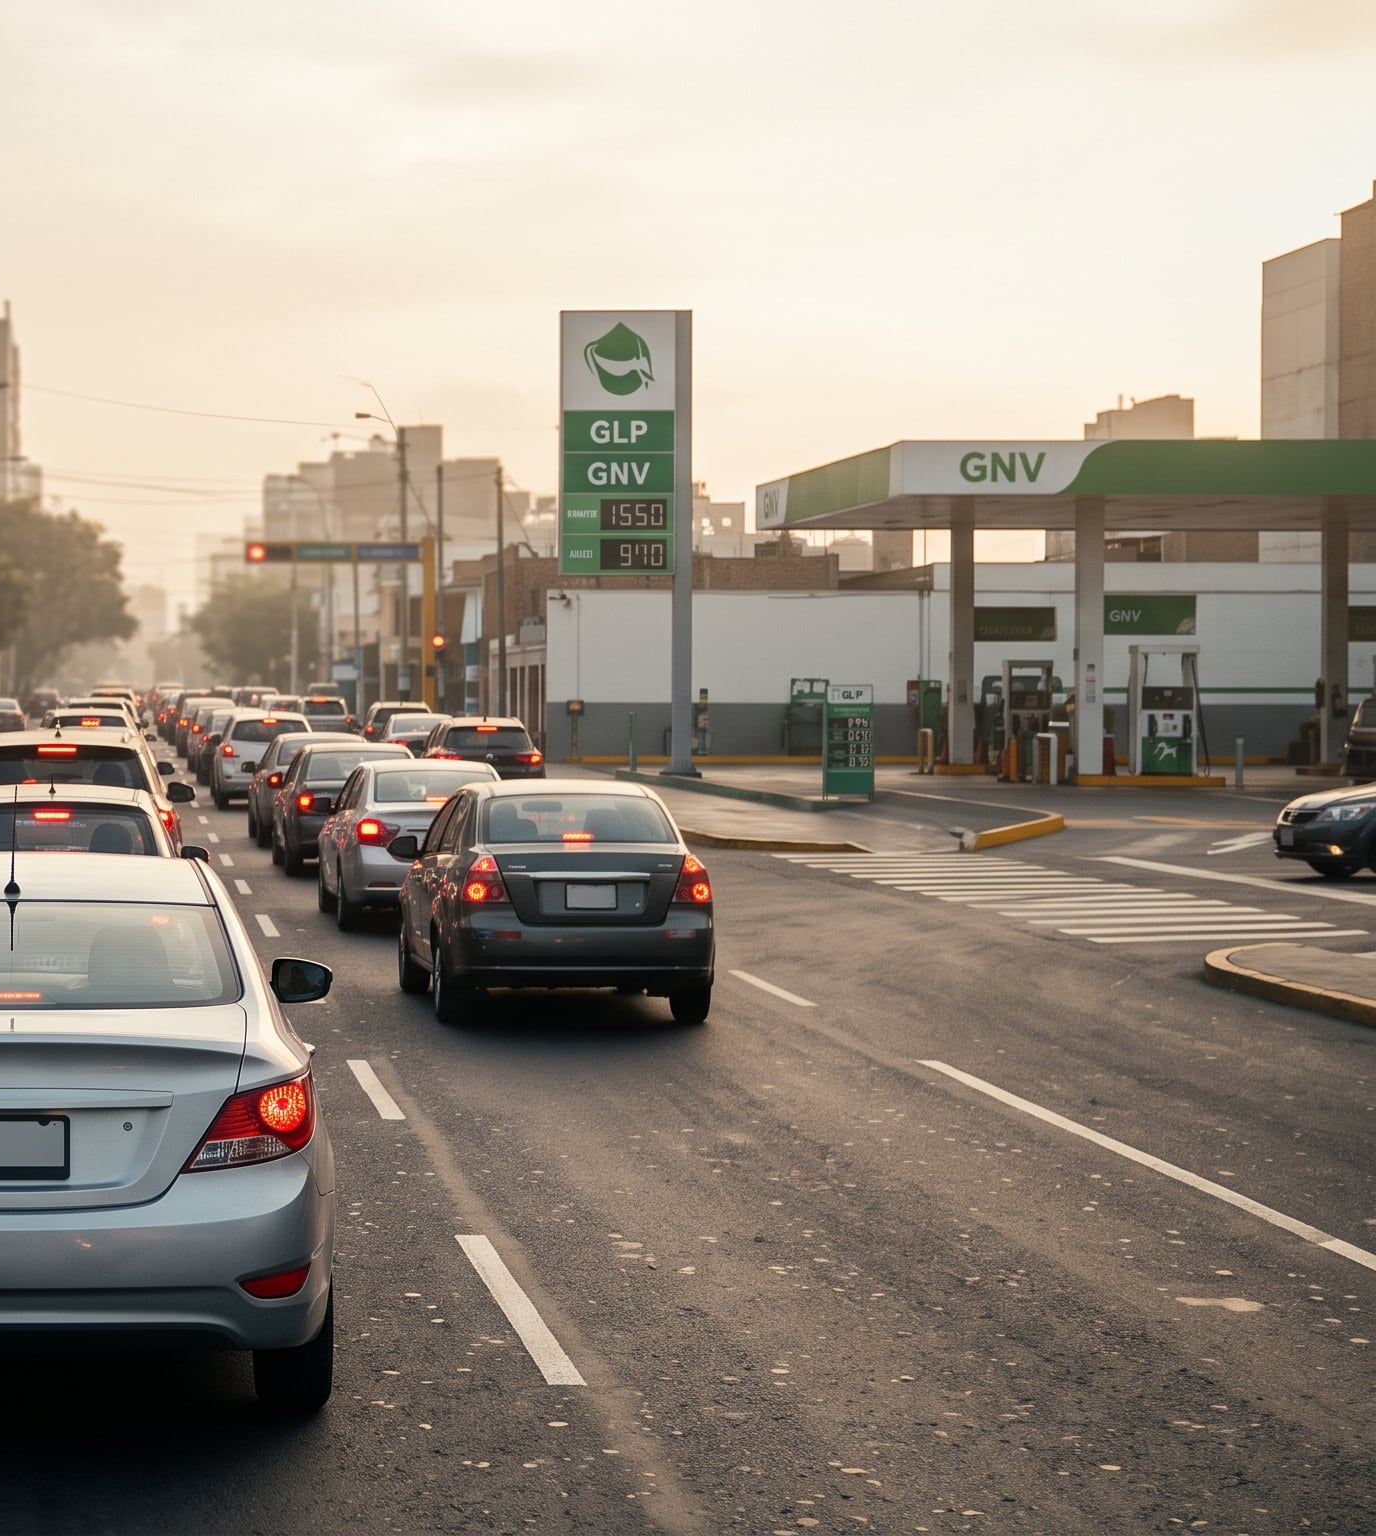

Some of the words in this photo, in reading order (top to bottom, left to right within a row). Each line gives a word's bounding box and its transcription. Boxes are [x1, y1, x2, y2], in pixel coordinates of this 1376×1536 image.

[589, 419, 648, 445] GLP
[586, 461, 651, 486] GNV
[959, 451, 1046, 483] GNV
[612, 503, 663, 526] 1550
[763, 488, 780, 520] GNV
[1109, 609, 1142, 622] GNV
